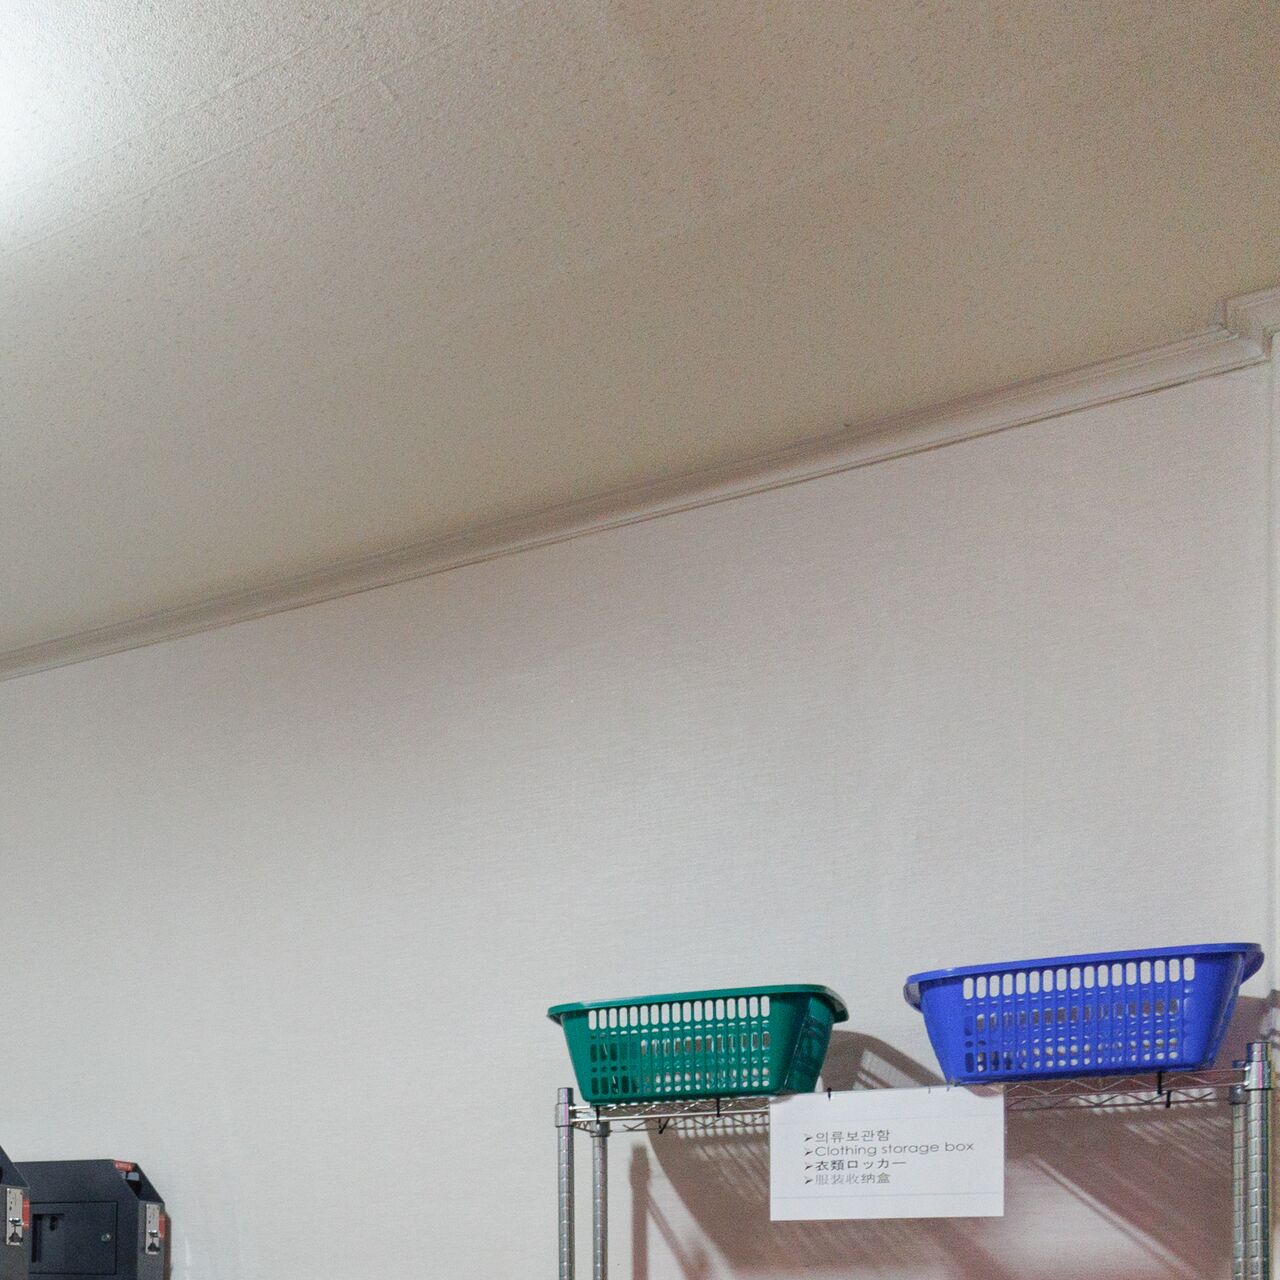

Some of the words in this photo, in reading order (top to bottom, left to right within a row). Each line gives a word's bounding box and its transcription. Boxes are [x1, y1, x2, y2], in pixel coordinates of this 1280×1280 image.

[815, 1130, 891, 1144] 의류보관함
[815, 1145, 877, 1157] Clothing
[881, 1143, 940, 1155] storage
[945, 1141, 975, 1152] box
[815, 1159, 907, 1171] 衣類ロッカー
